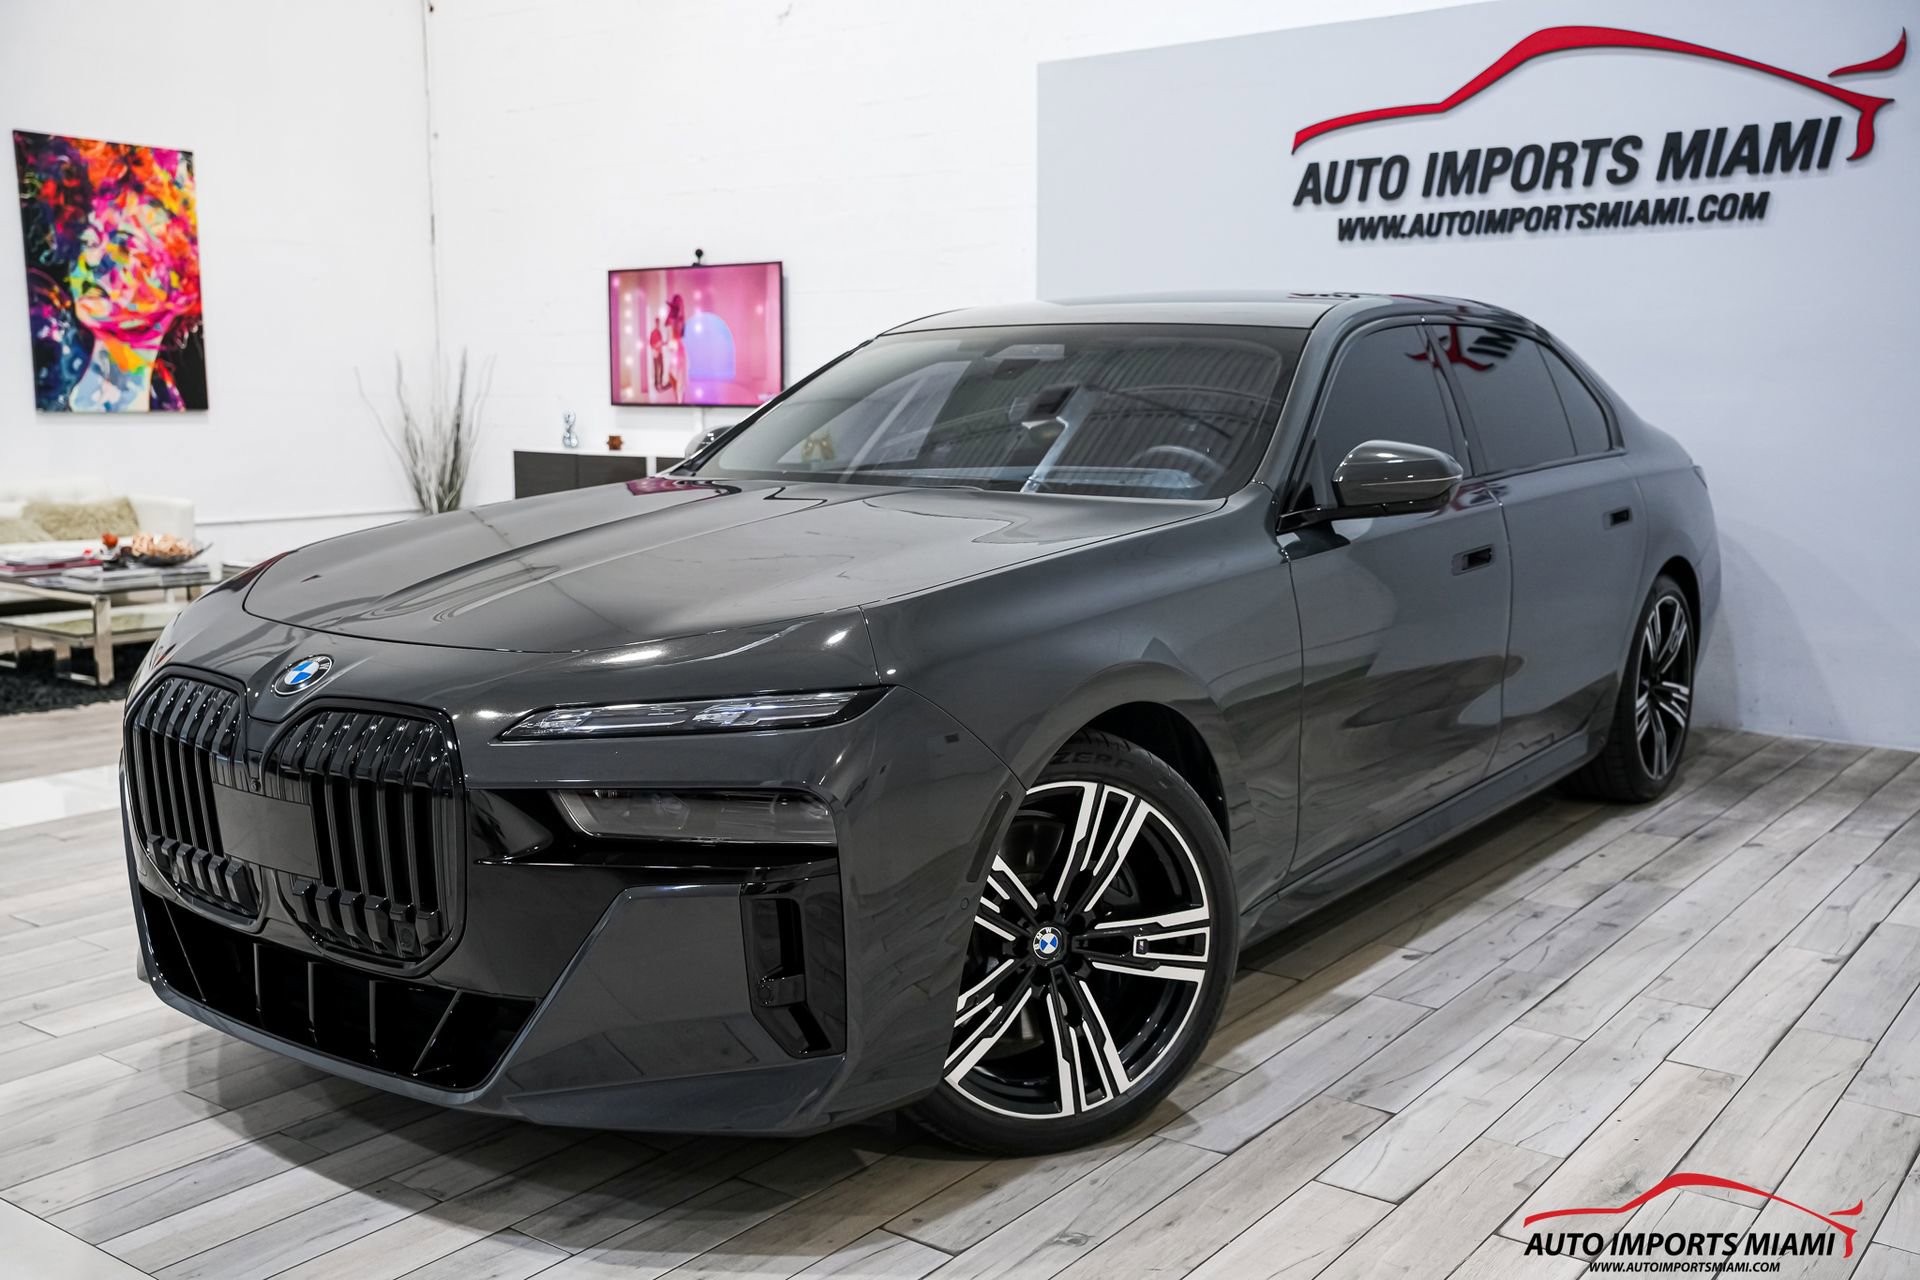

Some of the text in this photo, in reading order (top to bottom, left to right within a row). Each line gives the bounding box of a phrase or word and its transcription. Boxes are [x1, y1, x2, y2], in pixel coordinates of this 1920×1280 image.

[1292, 116, 1843, 207] AUTO IMPORTS MIAMI
[1338, 191, 1771, 242] WWW.AUTOIMPORTSMIAMI.COM
